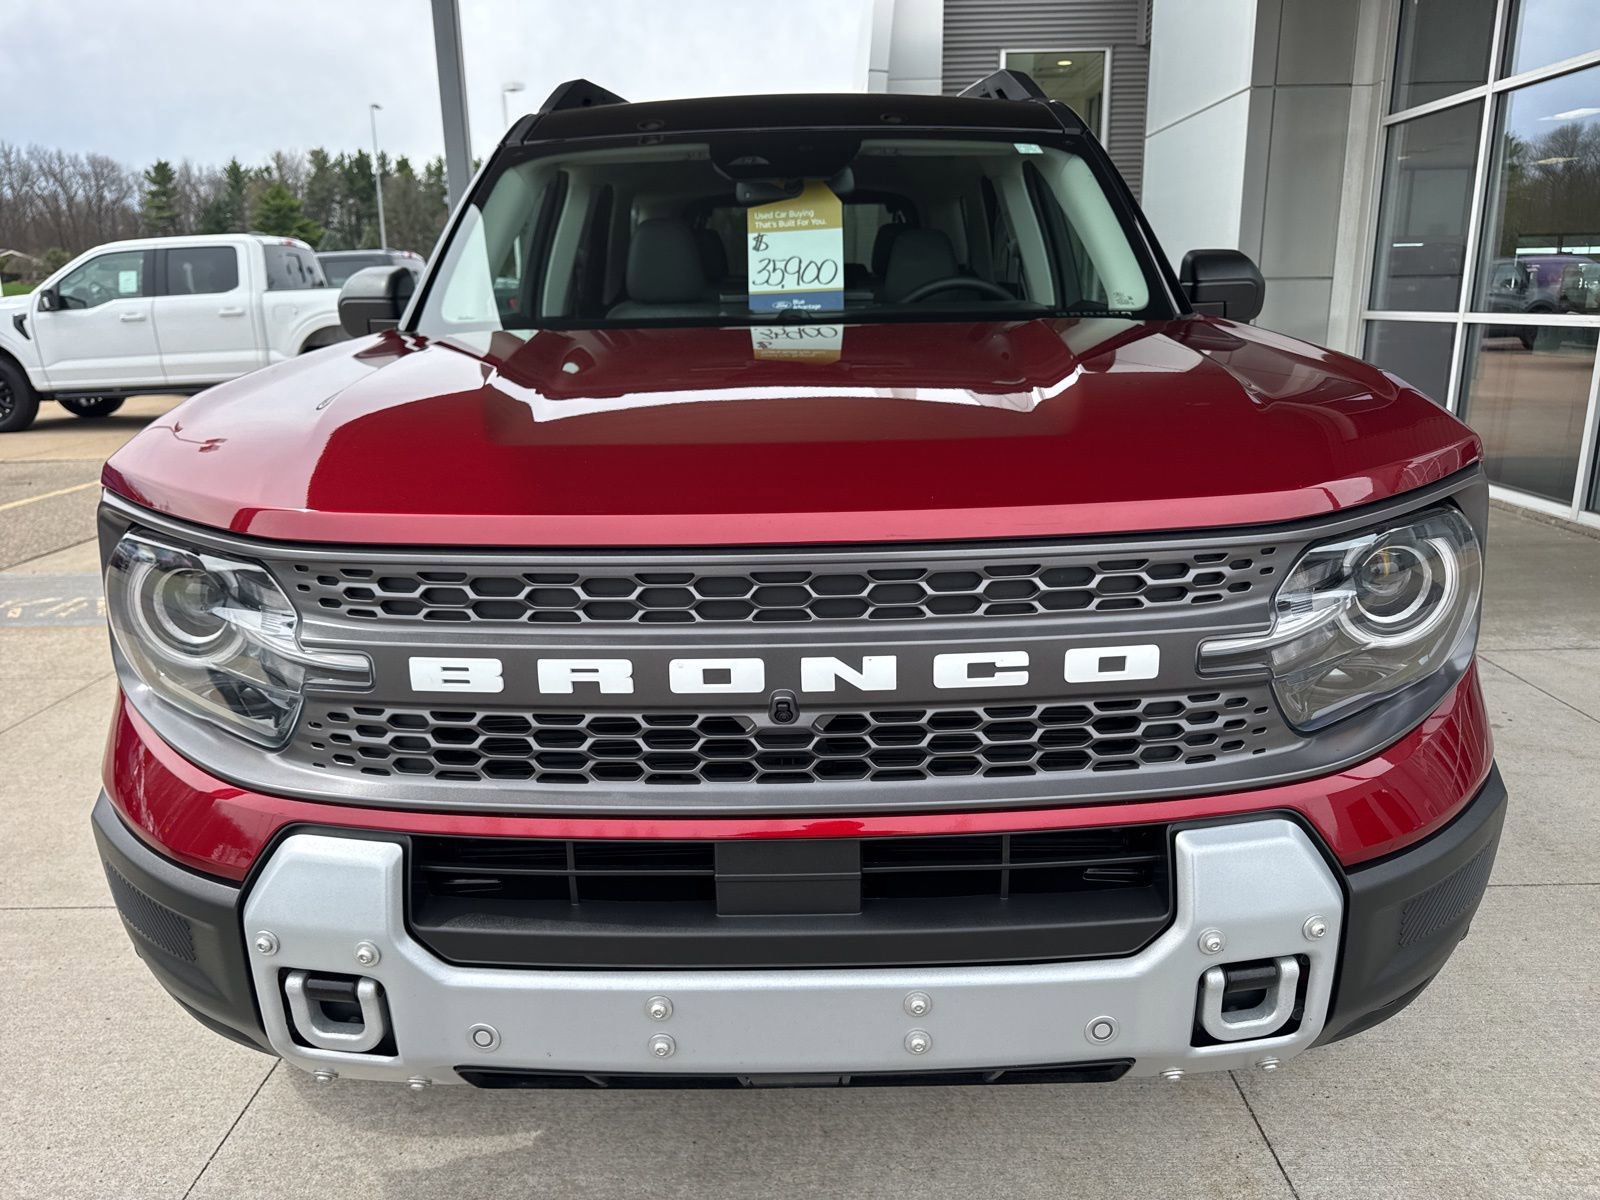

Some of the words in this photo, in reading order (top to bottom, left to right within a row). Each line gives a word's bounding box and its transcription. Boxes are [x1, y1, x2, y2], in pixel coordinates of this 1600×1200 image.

[754, 211, 774, 219] Used
[789, 210, 814, 218] Buying
[779, 220, 796, 228] Built
[797, 219, 810, 227] For
[752, 233, 769, 252] $
[752, 256, 838, 288] 35,900
[408, 643, 1161, 695] BRONCO
